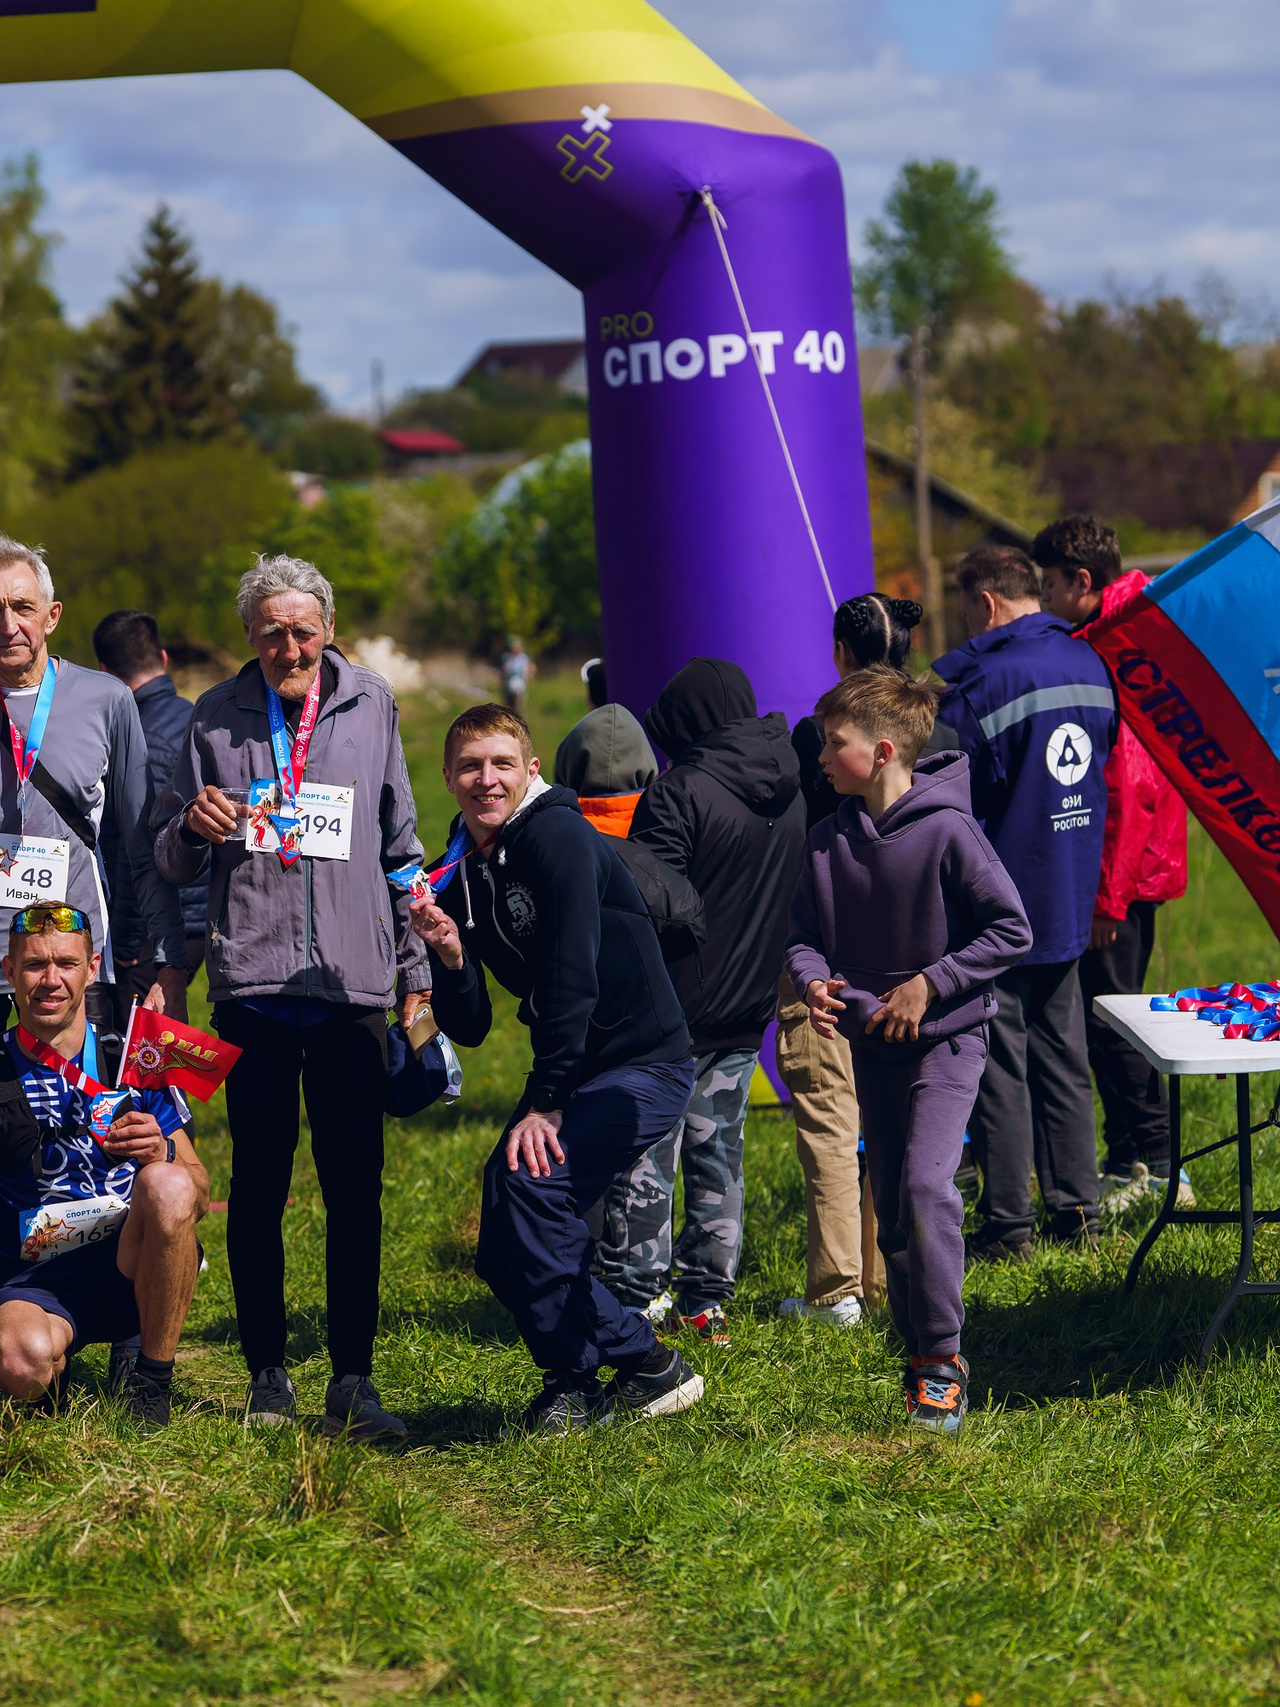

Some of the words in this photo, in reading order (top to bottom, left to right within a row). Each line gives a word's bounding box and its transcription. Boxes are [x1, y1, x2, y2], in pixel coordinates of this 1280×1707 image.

[600, 311, 654, 342] PRO
[603, 330, 784, 388] СПОРТ
[793, 329, 846, 375] 40
[1061, 794, 1082, 809] ФЭИ
[300, 814, 342, 837] 194
[20, 867, 53, 888] 48
[6, 887, 38, 900] Иван
[158, 1031, 175, 1046] 9
[174, 1038, 219, 1063] МАЯ
[65, 1210, 91, 1219] СПОРТ
[75, 1223, 116, 1244] 165
